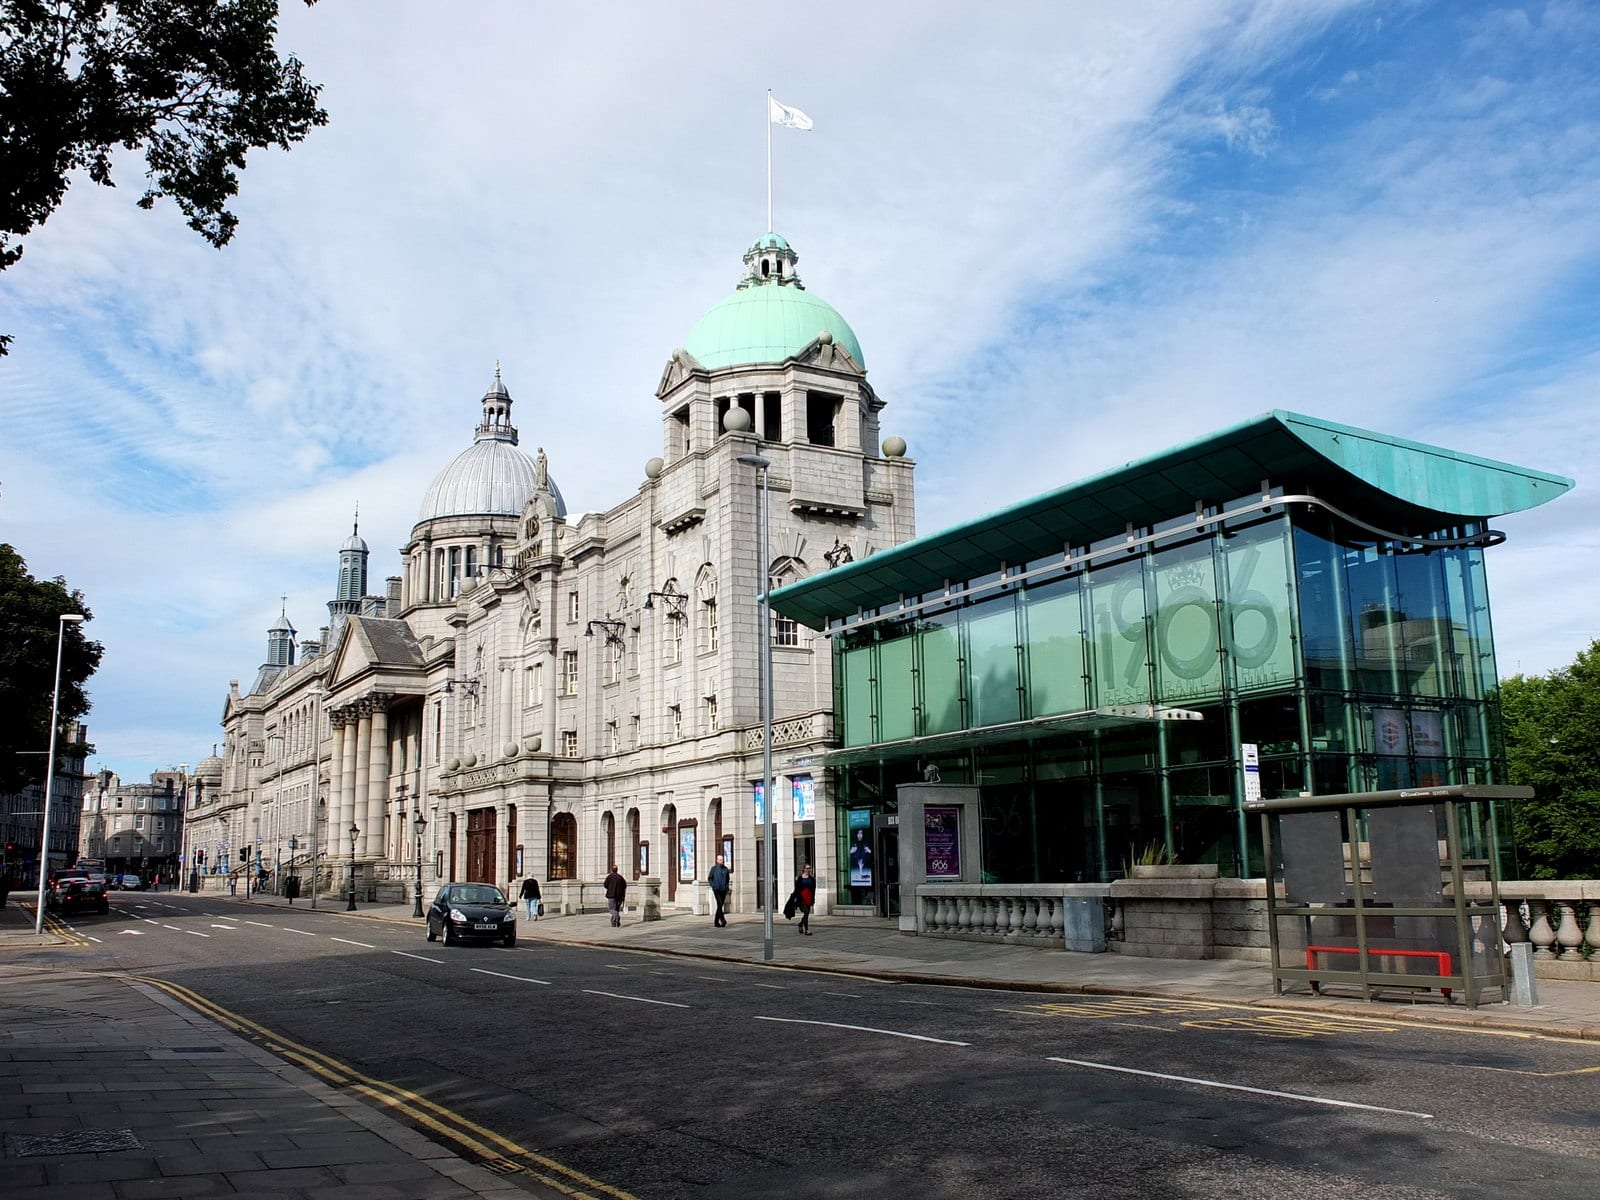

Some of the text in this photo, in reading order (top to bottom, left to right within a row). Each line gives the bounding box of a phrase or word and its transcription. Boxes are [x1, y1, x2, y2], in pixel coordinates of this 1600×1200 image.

[1095, 548, 1278, 689] 1906
[1104, 675, 1208, 706] RESTARANT
[1242, 663, 1279, 687] HMT
[931, 859, 948, 870] 1906
